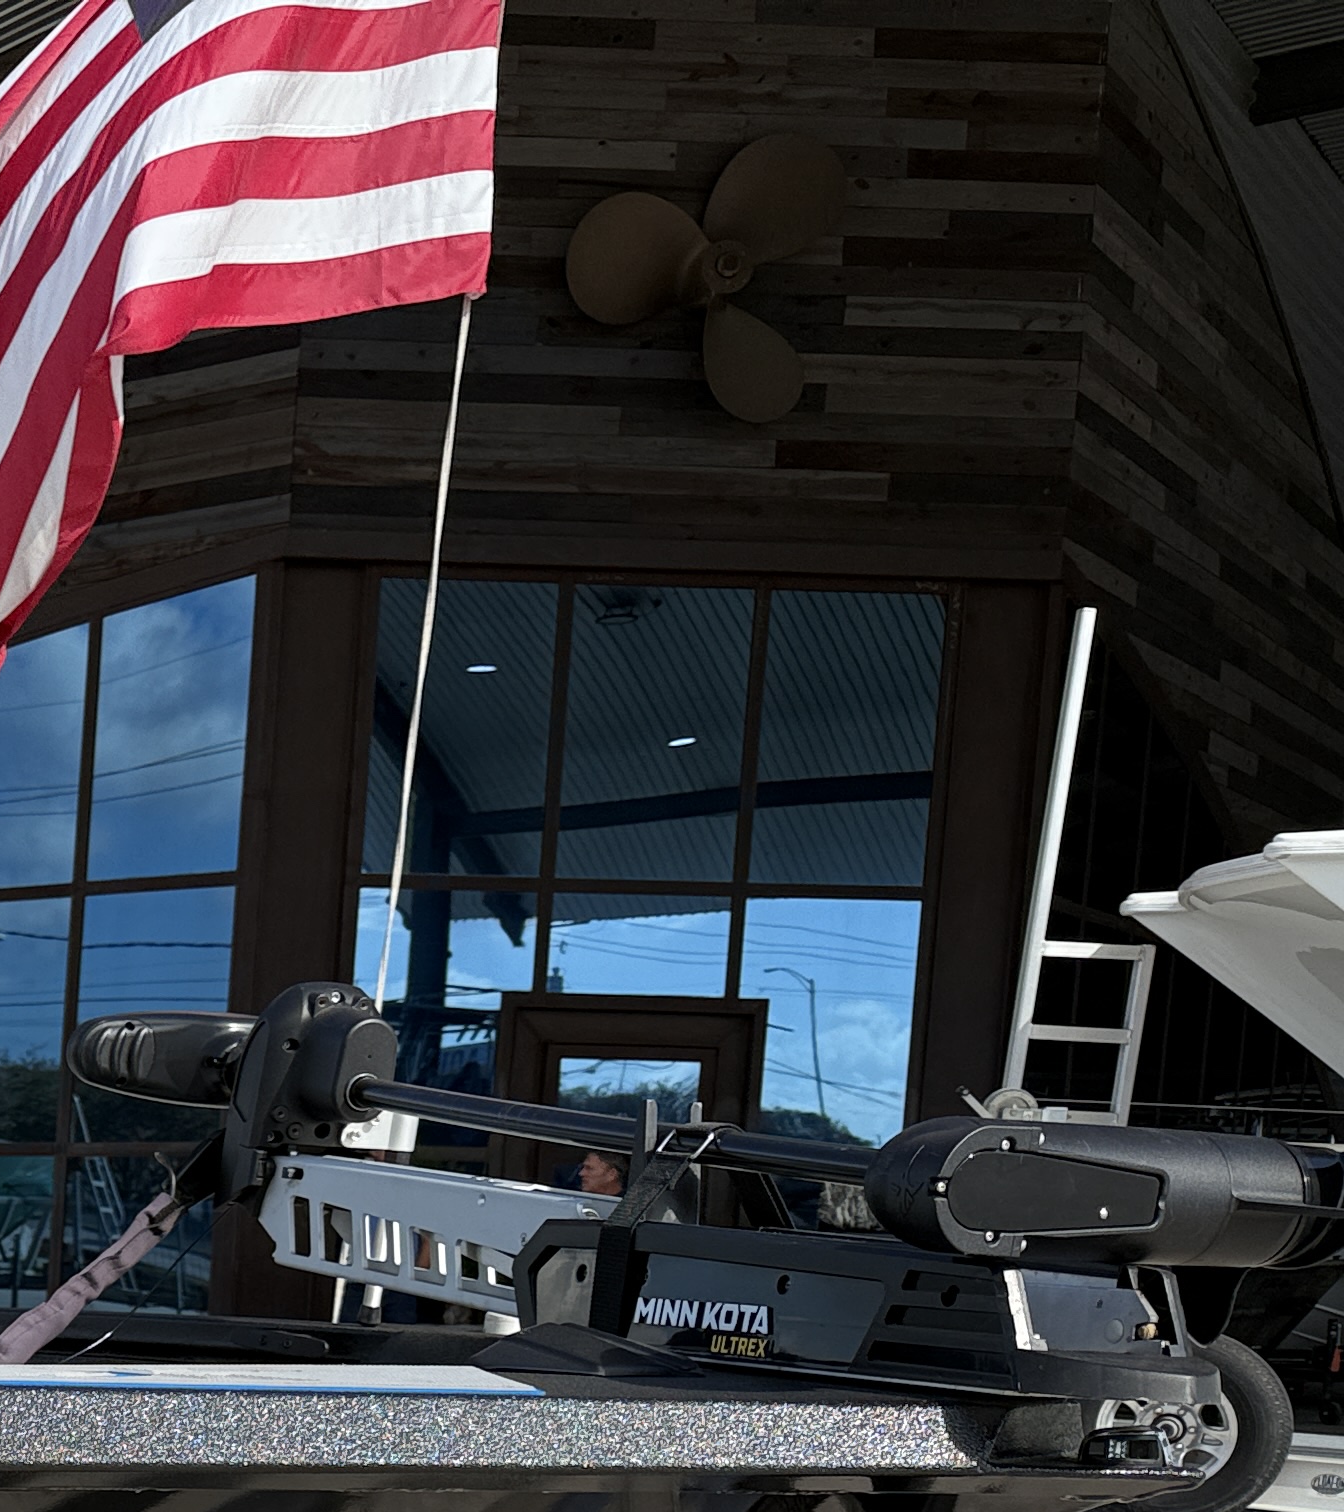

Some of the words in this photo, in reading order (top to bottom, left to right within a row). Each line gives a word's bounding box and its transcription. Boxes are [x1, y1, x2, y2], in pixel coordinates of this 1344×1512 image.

[633, 1296, 700, 1329] MINN
[701, 1301, 769, 1335] KOTA
[711, 1334, 768, 1358] ULTREX
